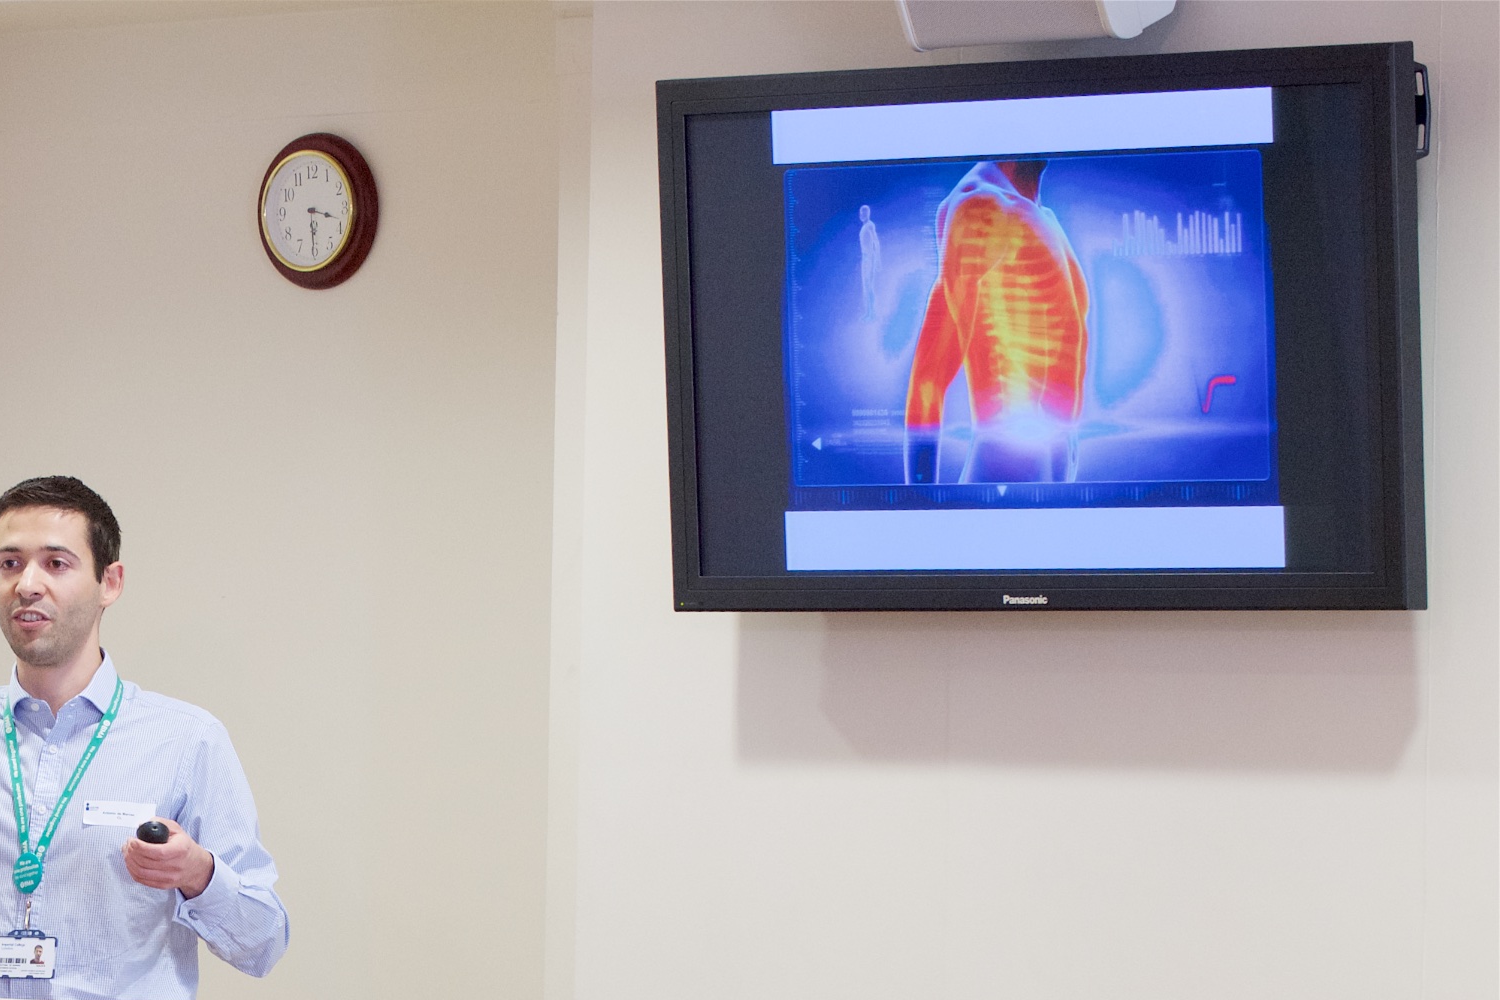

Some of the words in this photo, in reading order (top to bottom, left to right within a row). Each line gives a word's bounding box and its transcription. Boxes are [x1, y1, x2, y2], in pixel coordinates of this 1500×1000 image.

[306, 165, 318, 179] 12
[325, 169, 330, 182] 1
[294, 172, 302, 187] 11
[284, 188, 295, 202] 10
[335, 181, 343, 196] 2
[279, 206, 287, 221] 9
[341, 200, 349, 215] 3
[284, 226, 292, 240] 8
[296, 238, 304, 253] 7
[311, 242, 319, 257] 6
[326, 236, 334, 250] 5
[1002, 594, 1049, 605] Panasonic
